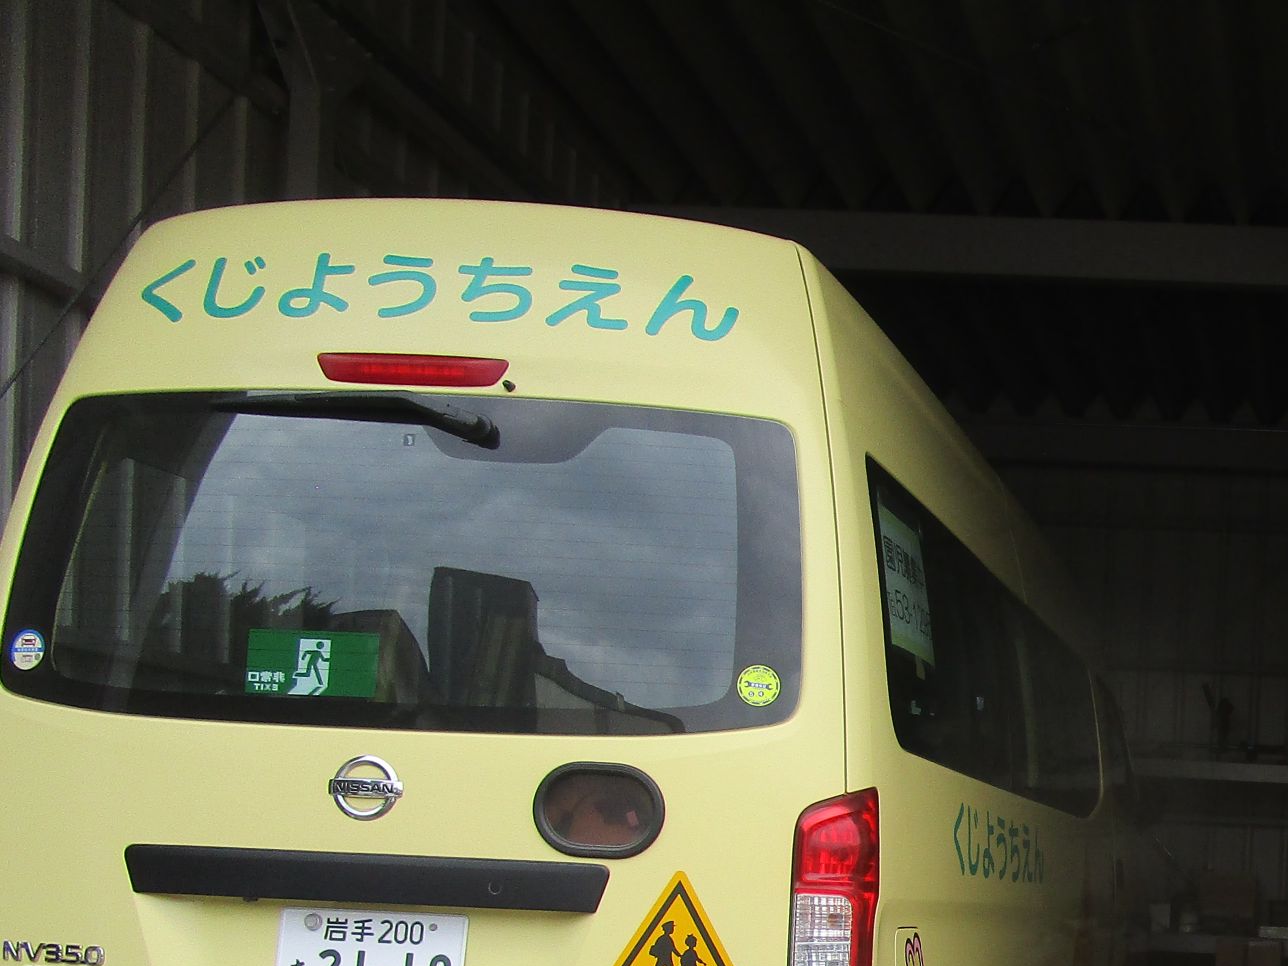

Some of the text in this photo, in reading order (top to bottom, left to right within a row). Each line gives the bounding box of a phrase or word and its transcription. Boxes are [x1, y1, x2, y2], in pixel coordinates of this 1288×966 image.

[140, 252, 740, 342] くじようちえん
[332, 781, 395, 794] NISSAN
[953, 801, 1044, 884] くじようちえん
[324, 916, 425, 945] 岩手200
[2, 939, 105, 966] NV350
